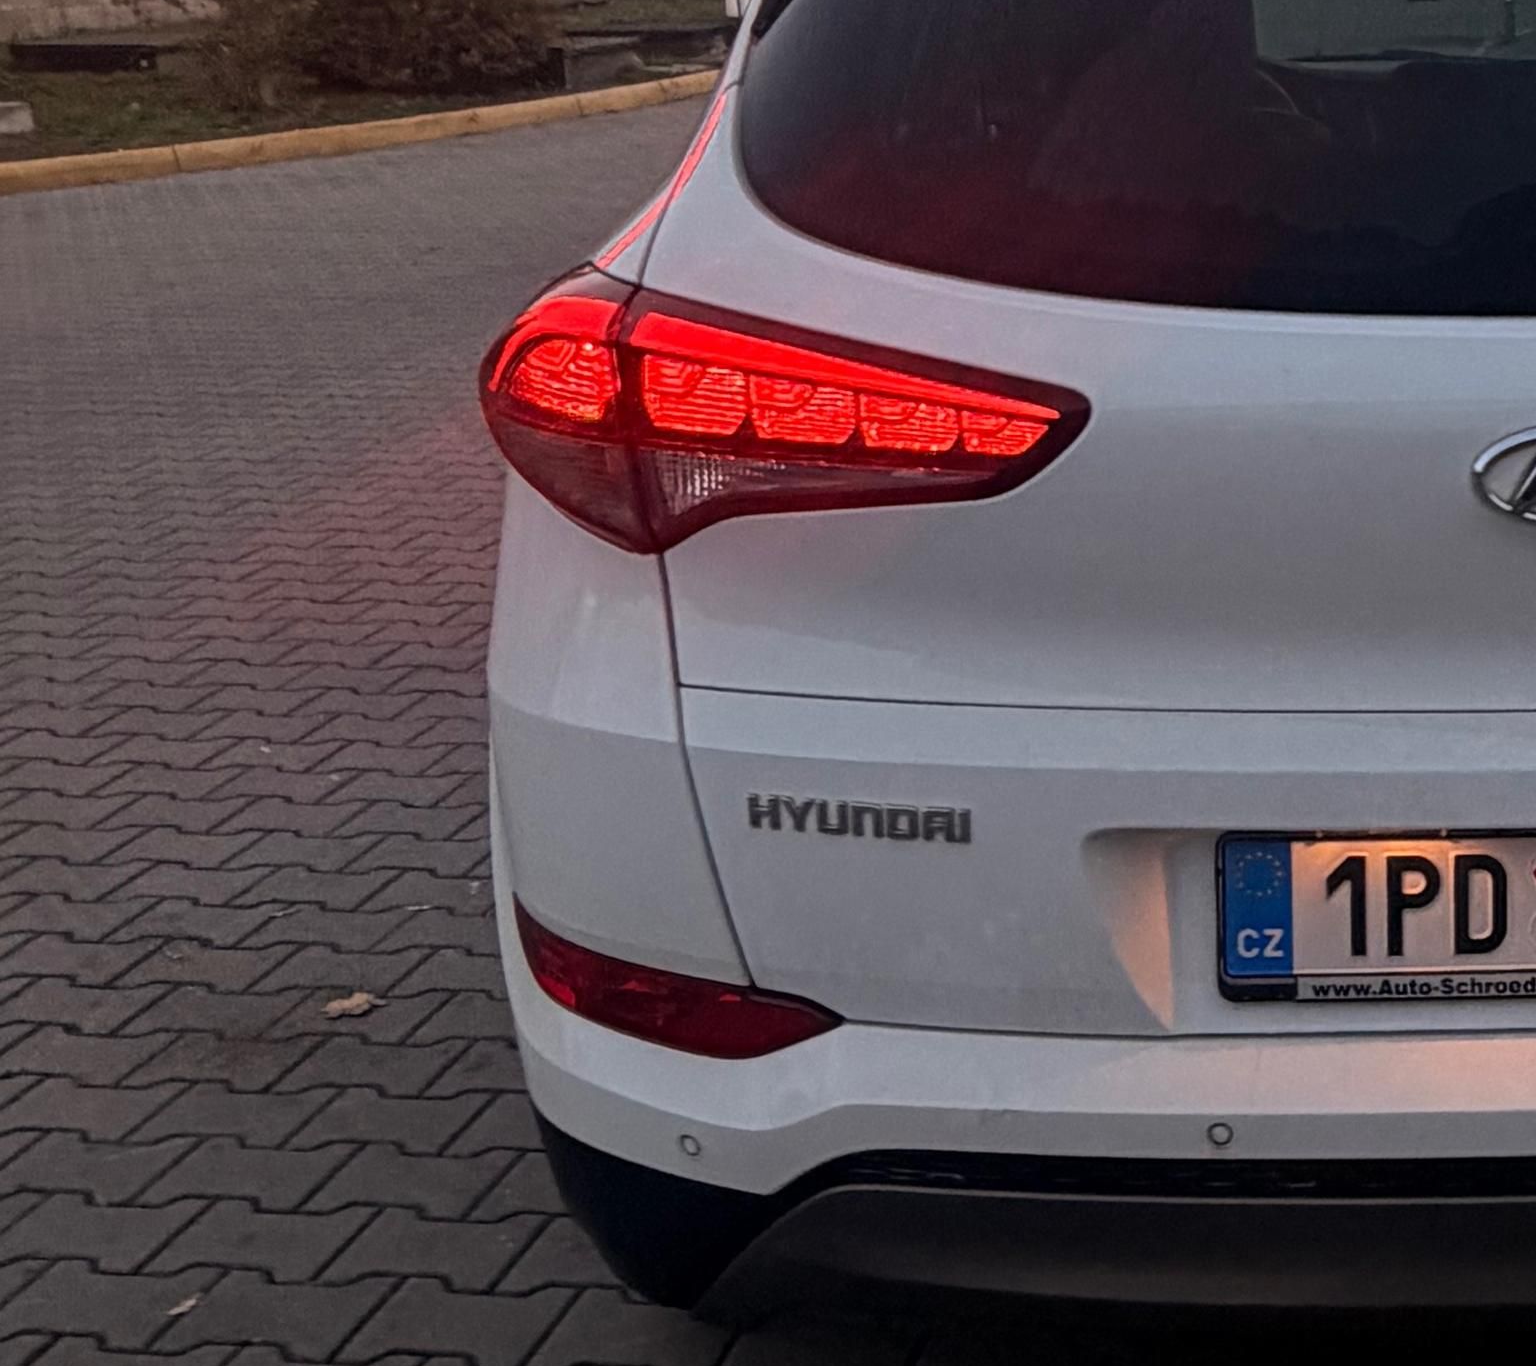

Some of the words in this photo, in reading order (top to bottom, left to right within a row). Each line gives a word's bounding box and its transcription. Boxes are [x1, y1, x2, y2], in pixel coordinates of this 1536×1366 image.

[747, 793, 972, 845] HYUNDAI
[1324, 854, 1508, 957] 1PD
[1236, 928, 1284, 959] CZ
